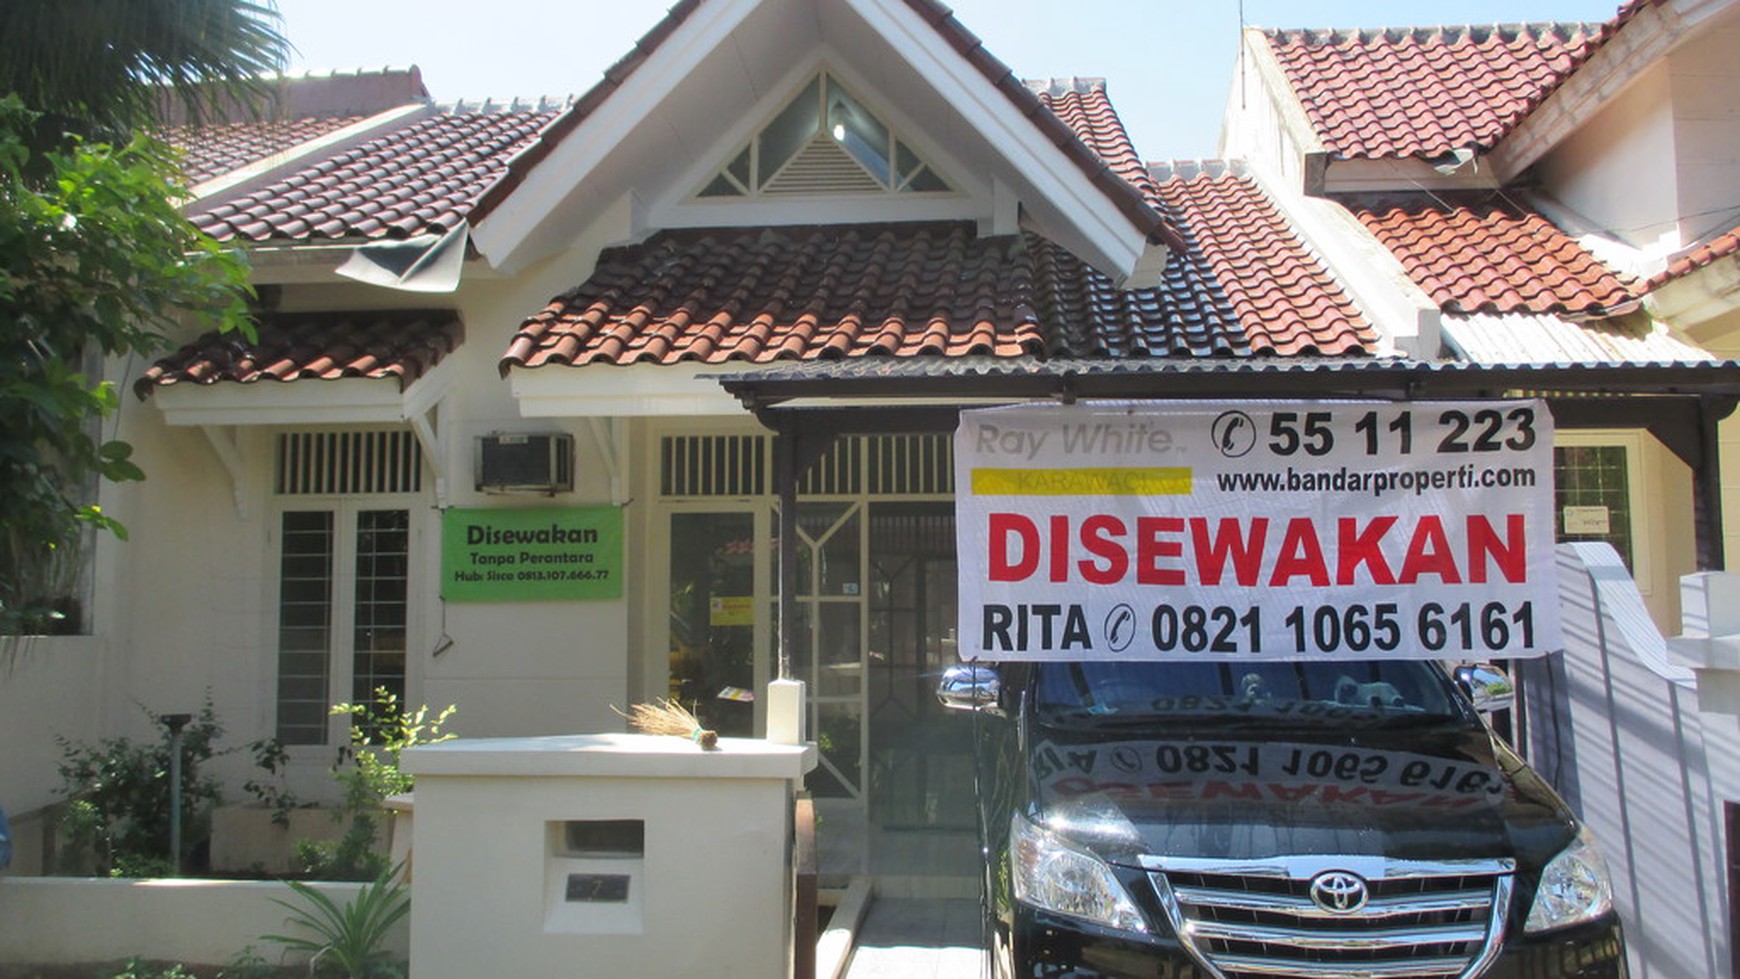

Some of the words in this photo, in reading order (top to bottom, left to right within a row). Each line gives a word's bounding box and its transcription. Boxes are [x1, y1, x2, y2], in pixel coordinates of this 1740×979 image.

[976, 424, 1048, 460] Ray
[1062, 422, 1172, 454] White
[1269, 412, 1333, 456] 55
[1355, 411, 1411, 455] 11
[1437, 408, 1536, 453] 223
[1016, 471, 1148, 491] KARAWACI
[1217, 464, 1536, 496] www.bandarproperti.com
[467, 525, 598, 545] Disewakan
[988, 513, 1526, 587] DISEWAKAN
[470, 552, 515, 566] Tanpa
[519, 552, 594, 565] Perantara
[982, 604, 1093, 651] RITA
[1152, 604, 1261, 653] 0821
[1285, 603, 1401, 653] 1065
[1418, 601, 1534, 651] 6161
